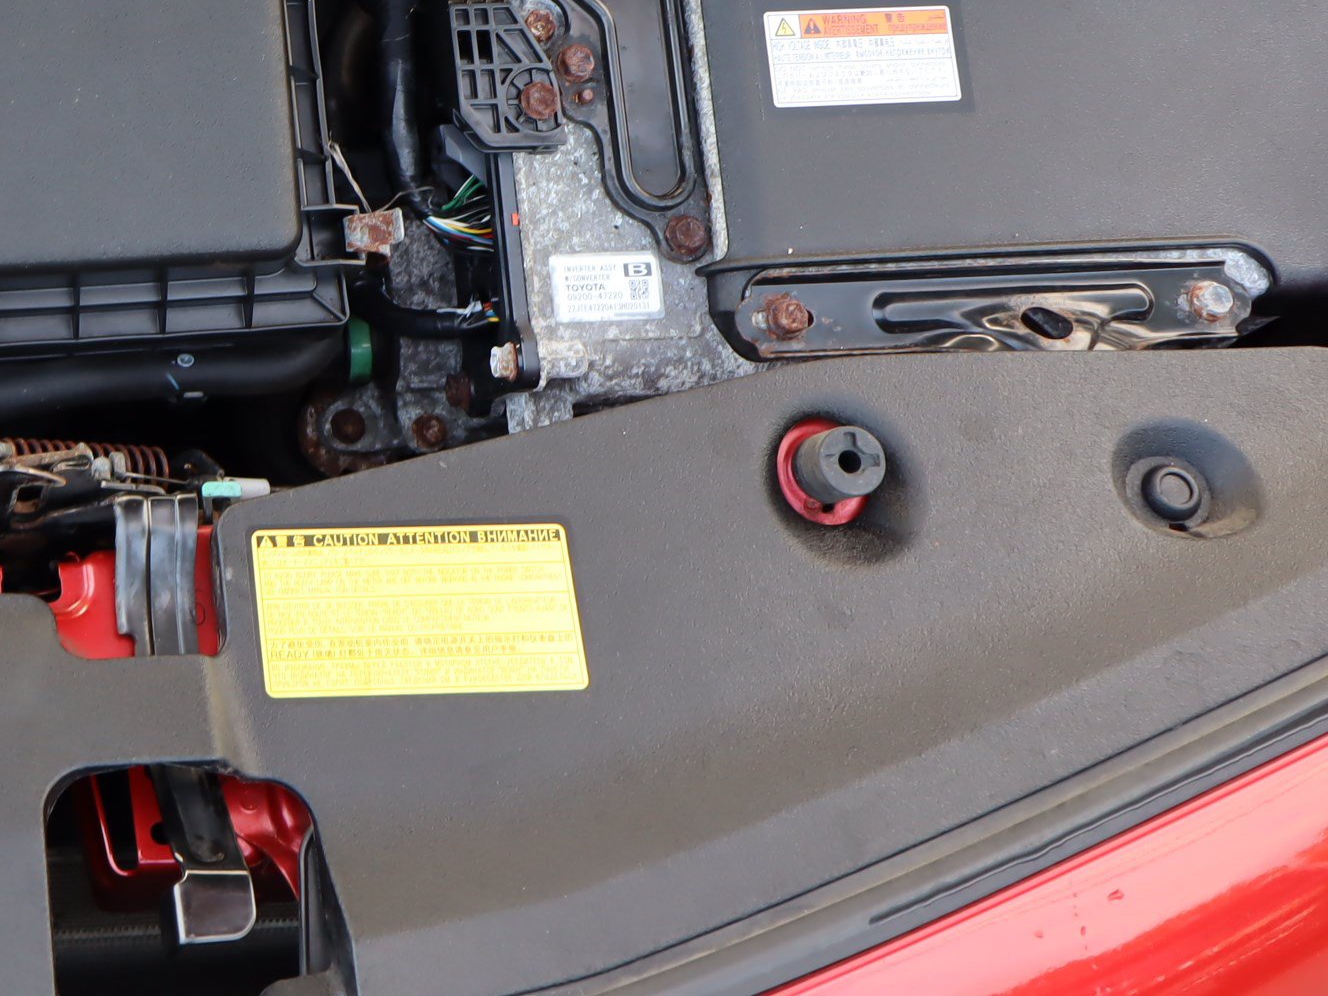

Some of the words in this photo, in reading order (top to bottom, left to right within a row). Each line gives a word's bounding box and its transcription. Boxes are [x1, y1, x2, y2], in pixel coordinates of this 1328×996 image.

[822, 13, 867, 24] WARNING
[565, 283, 606, 292] TOYOTA
[313, 533, 379, 546] CAUTION
[387, 531, 471, 545] ATTENTION
[477, 529, 559, 543] ВНИМАНИЕ
